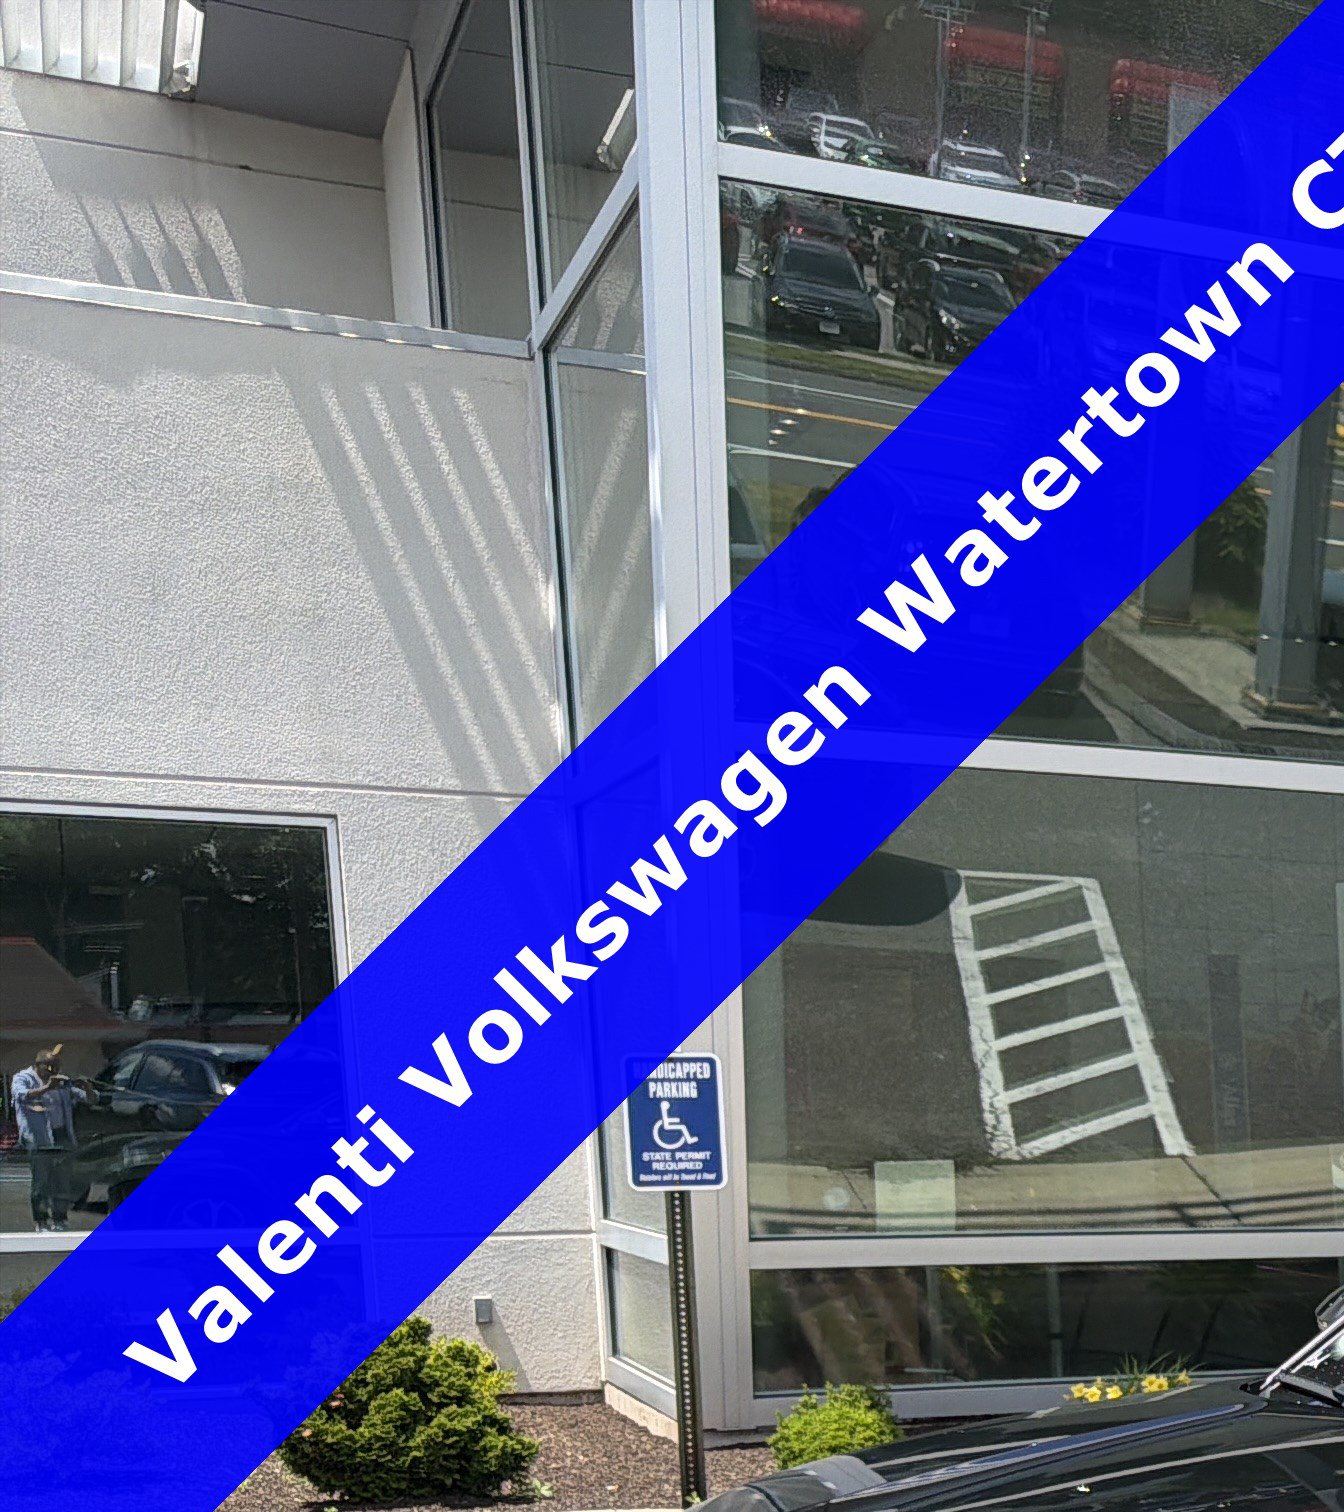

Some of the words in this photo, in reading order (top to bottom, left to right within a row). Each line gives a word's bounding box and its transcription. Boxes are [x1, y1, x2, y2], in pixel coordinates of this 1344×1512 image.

[634, 1062, 711, 1080] DICAPPED
[648, 1081, 698, 1099] PARKING
[642, 1151, 673, 1162] STATE
[674, 1150, 712, 1160] PERMIT
[652, 1161, 704, 1171] REQUIRED
